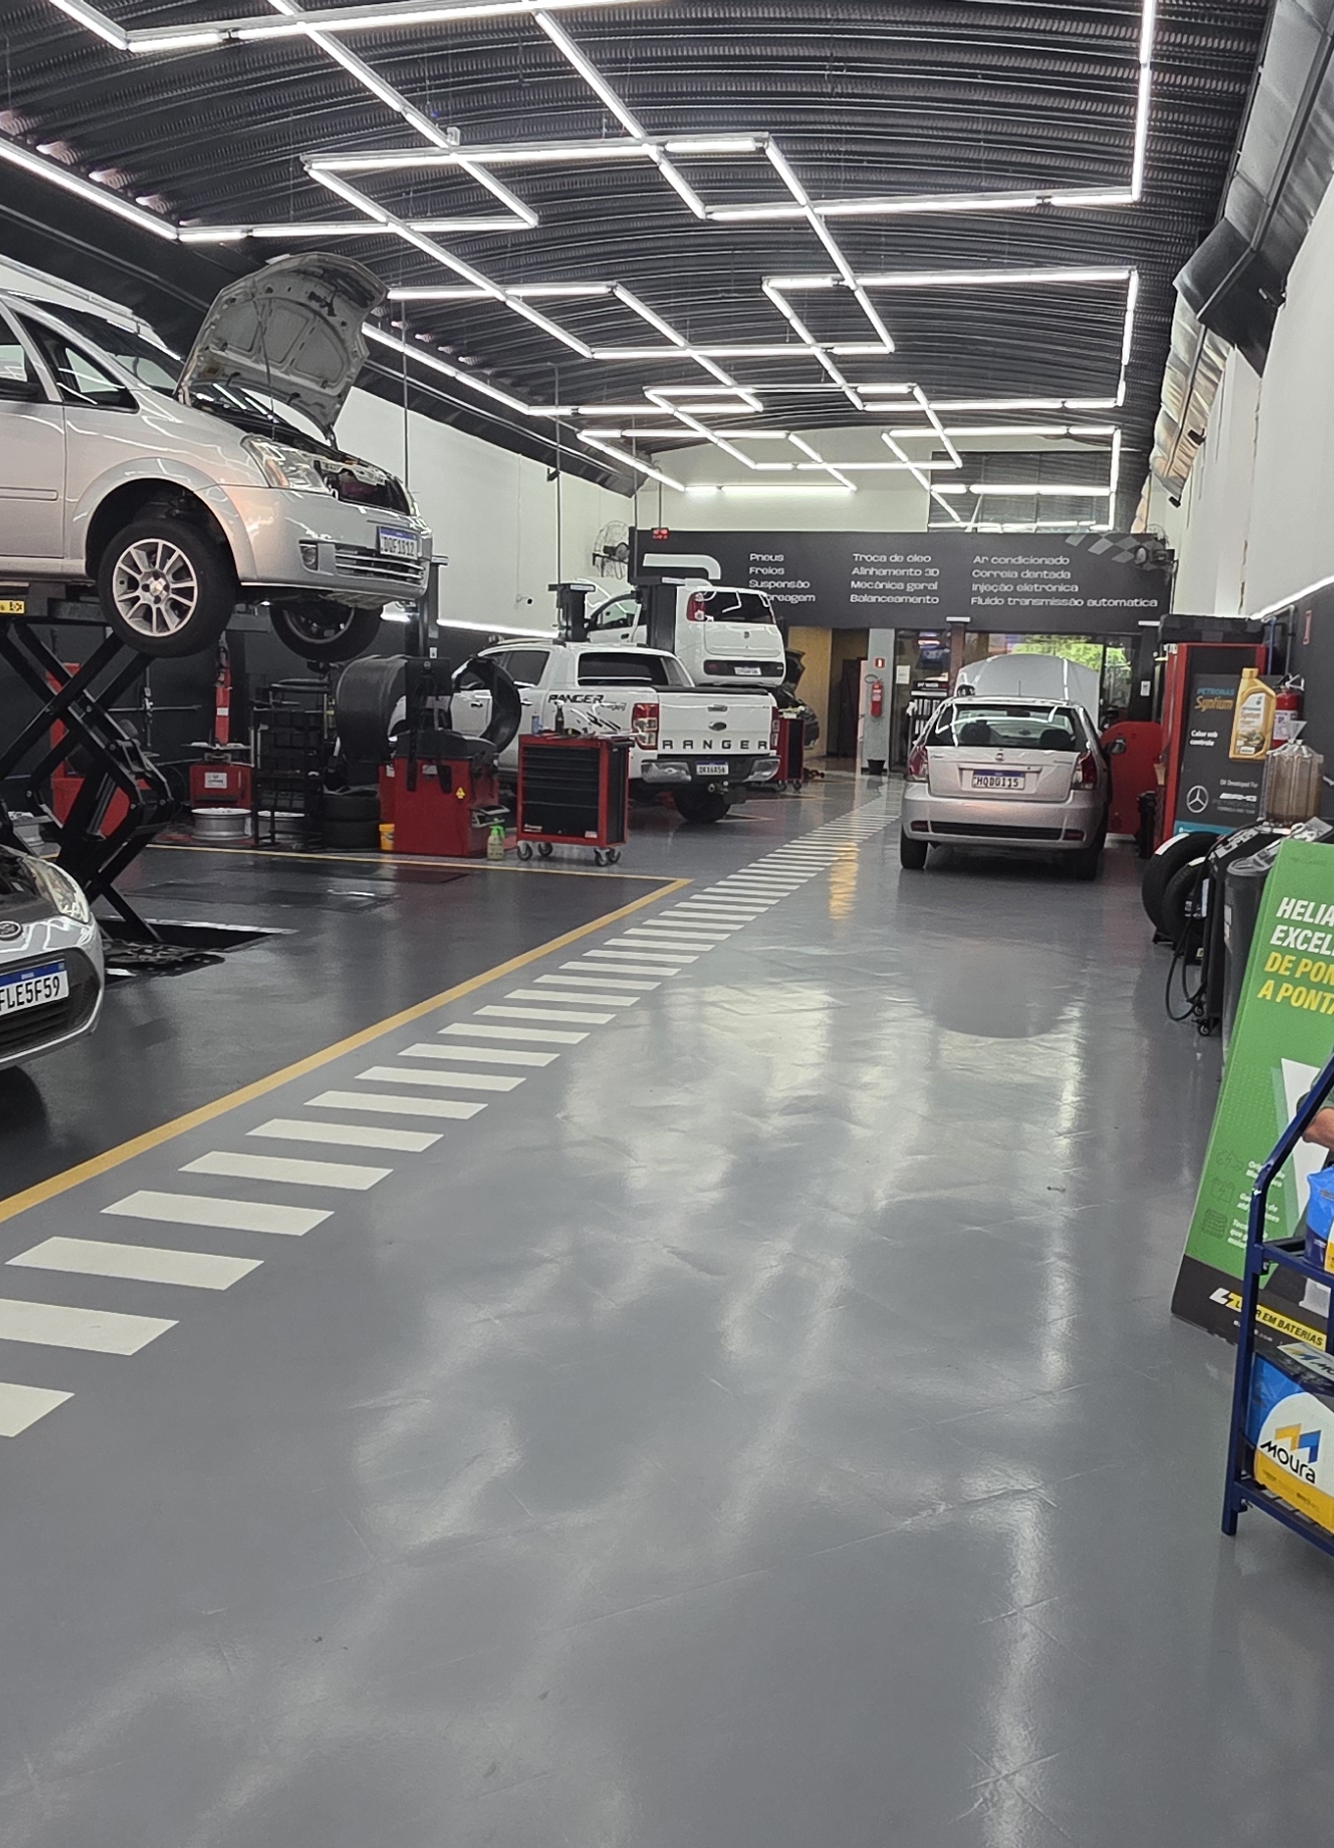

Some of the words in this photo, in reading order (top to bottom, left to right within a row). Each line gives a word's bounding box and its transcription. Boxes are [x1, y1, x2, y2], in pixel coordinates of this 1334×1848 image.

[750, 553, 784, 562] Pneus
[852, 553, 887, 562] Troca
[889, 554, 904, 562] de
[906, 553, 932, 563] óleo
[973, 556, 988, 564] Ar
[991, 556, 1070, 565] condicionado
[749, 566, 785, 575] Freios
[852, 567, 922, 576] Alinhamento
[924, 568, 940, 576] 3D
[972, 570, 1018, 578] Correia
[1021, 570, 1071, 579] dentada
[749, 579, 810, 590] Suspensão
[850, 580, 905, 590] Mecânica
[906, 581, 939, 592] geral
[972, 583, 1014, 594] Injeção
[850, 594, 940, 604] Balanceamento
[971, 597, 1005, 606] Fluido
[1007, 597, 1084, 606] transmissão
[548, 694, 605, 704] RANGER
[662, 739, 768, 750] RANGER
[1264, 951, 1296, 976] DE
[1257, 979, 1275, 1000] A
[1262, 1311, 1278, 1326] EM
[1278, 1318, 1324, 1347] BATERIAS
